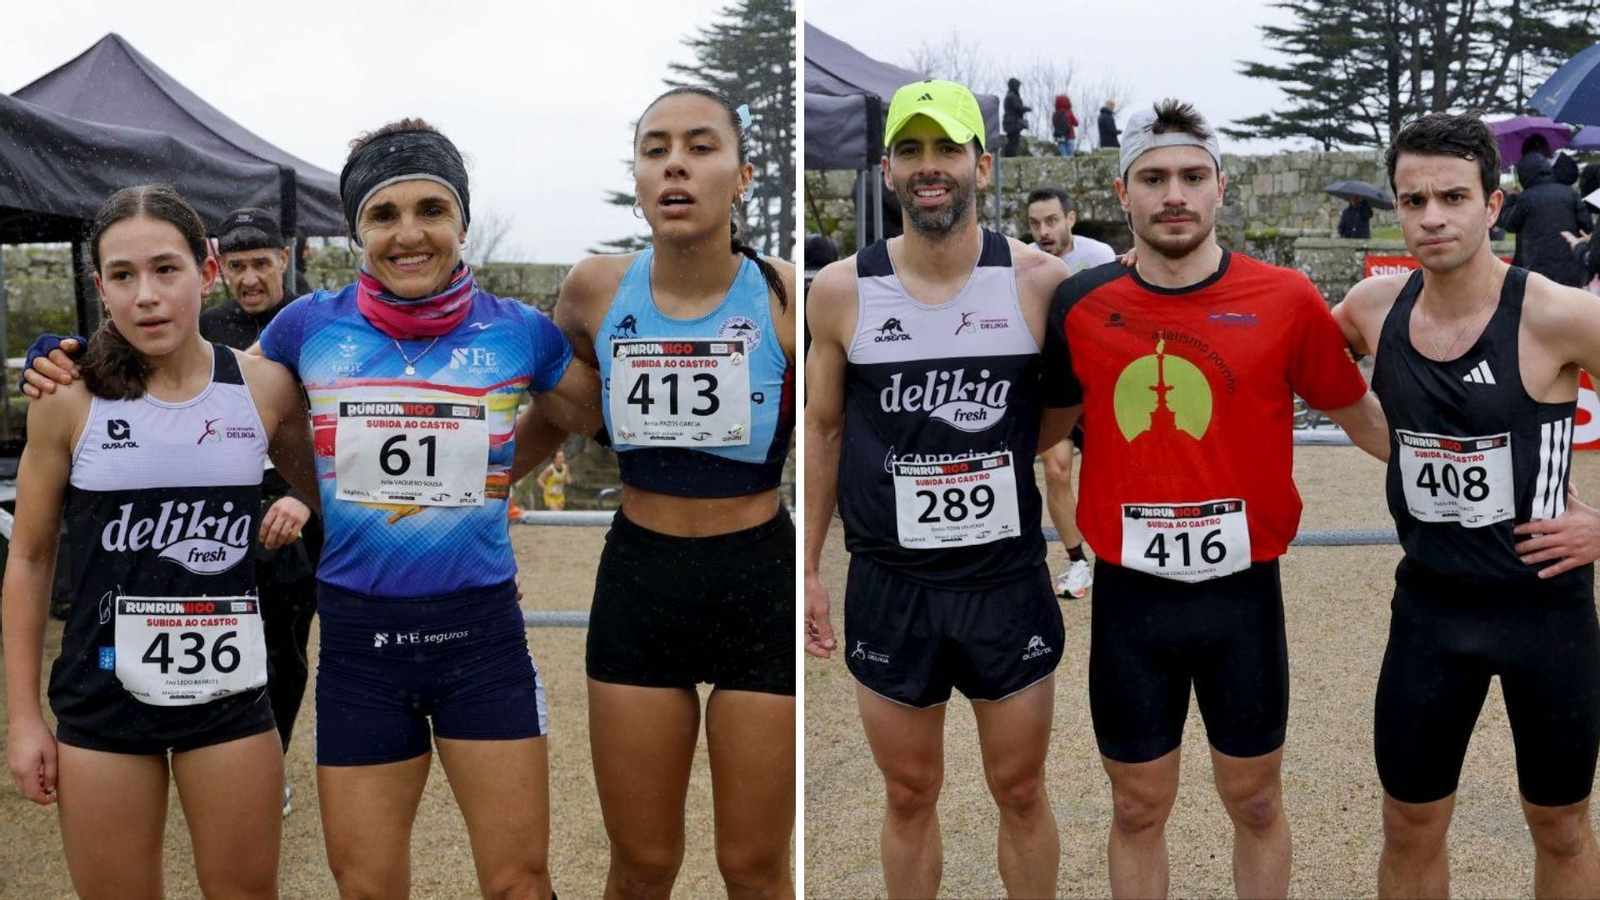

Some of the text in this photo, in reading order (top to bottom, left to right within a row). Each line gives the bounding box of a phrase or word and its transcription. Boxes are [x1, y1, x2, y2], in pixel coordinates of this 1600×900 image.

[631, 360, 718, 368] SUBIDA AO CASTRO
[627, 373, 720, 417] 413
[880, 368, 1011, 413] delikia
[954, 408, 987, 421] fresh
[366, 419, 459, 430] SUBIDA AO CASTRO
[226, 431, 255, 439] DELIKIA
[379, 434, 436, 477] 61
[1414, 450, 1442, 459] SUBIDA
[915, 473, 990, 486] SUBIDA AO CASTRO
[1416, 463, 1490, 502] 408
[916, 484, 995, 523] 289
[101, 500, 251, 552] delikia
[1147, 518, 1221, 529] SUBIDA AO CASTRO
[187, 547, 226, 563] fresh
[1144, 528, 1227, 567] 416
[147, 618, 238, 627] SUBIDA AO CASTRO
[424, 630, 469, 644] seguros
[141, 631, 241, 675] 436
